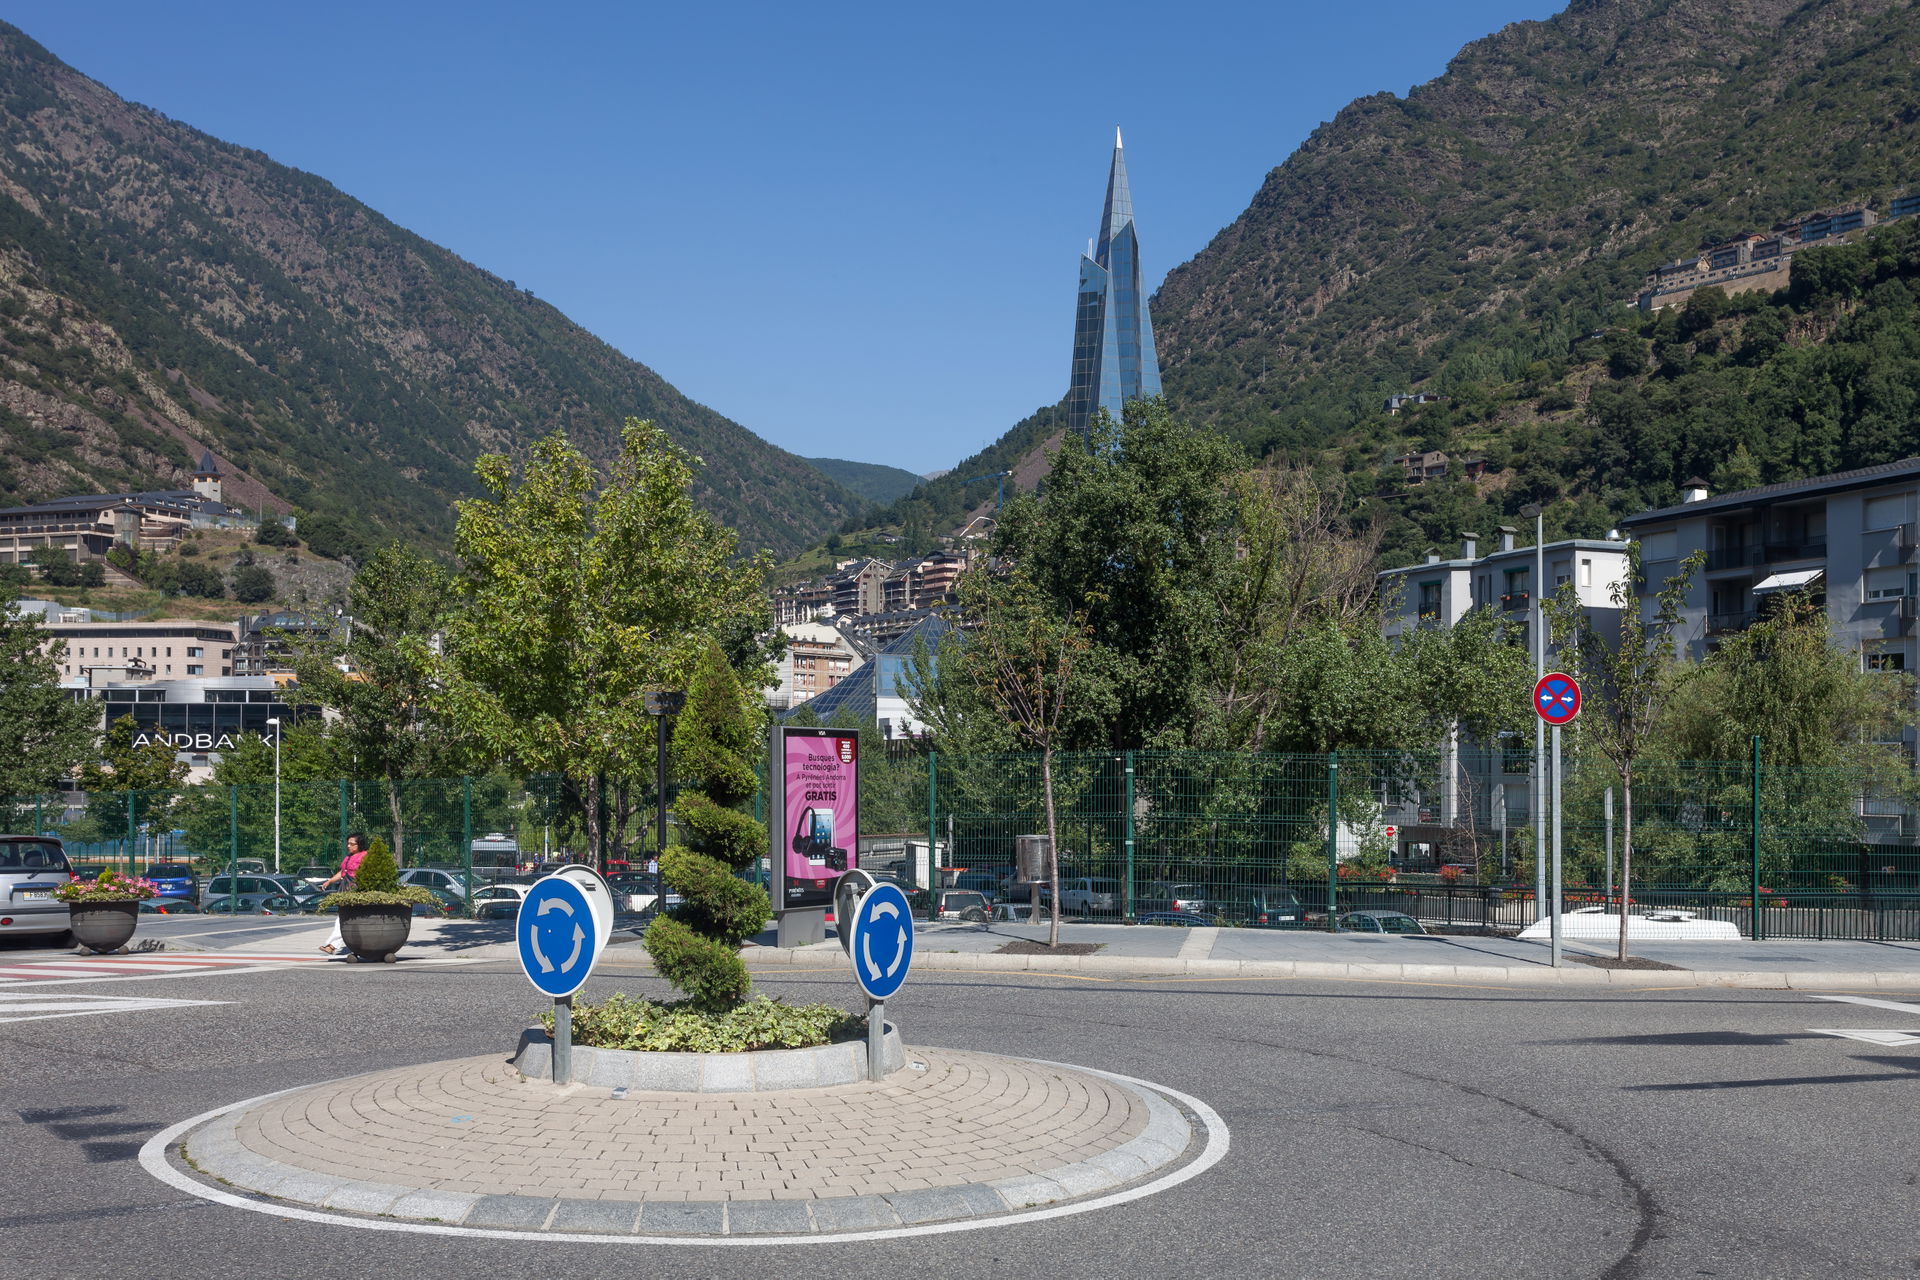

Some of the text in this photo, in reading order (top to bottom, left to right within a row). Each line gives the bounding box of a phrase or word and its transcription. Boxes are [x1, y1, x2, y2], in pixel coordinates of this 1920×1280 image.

[808, 753, 835, 763] Busques
[802, 763, 840, 773] tecnologia?
[805, 791, 837, 801] GRATIS
